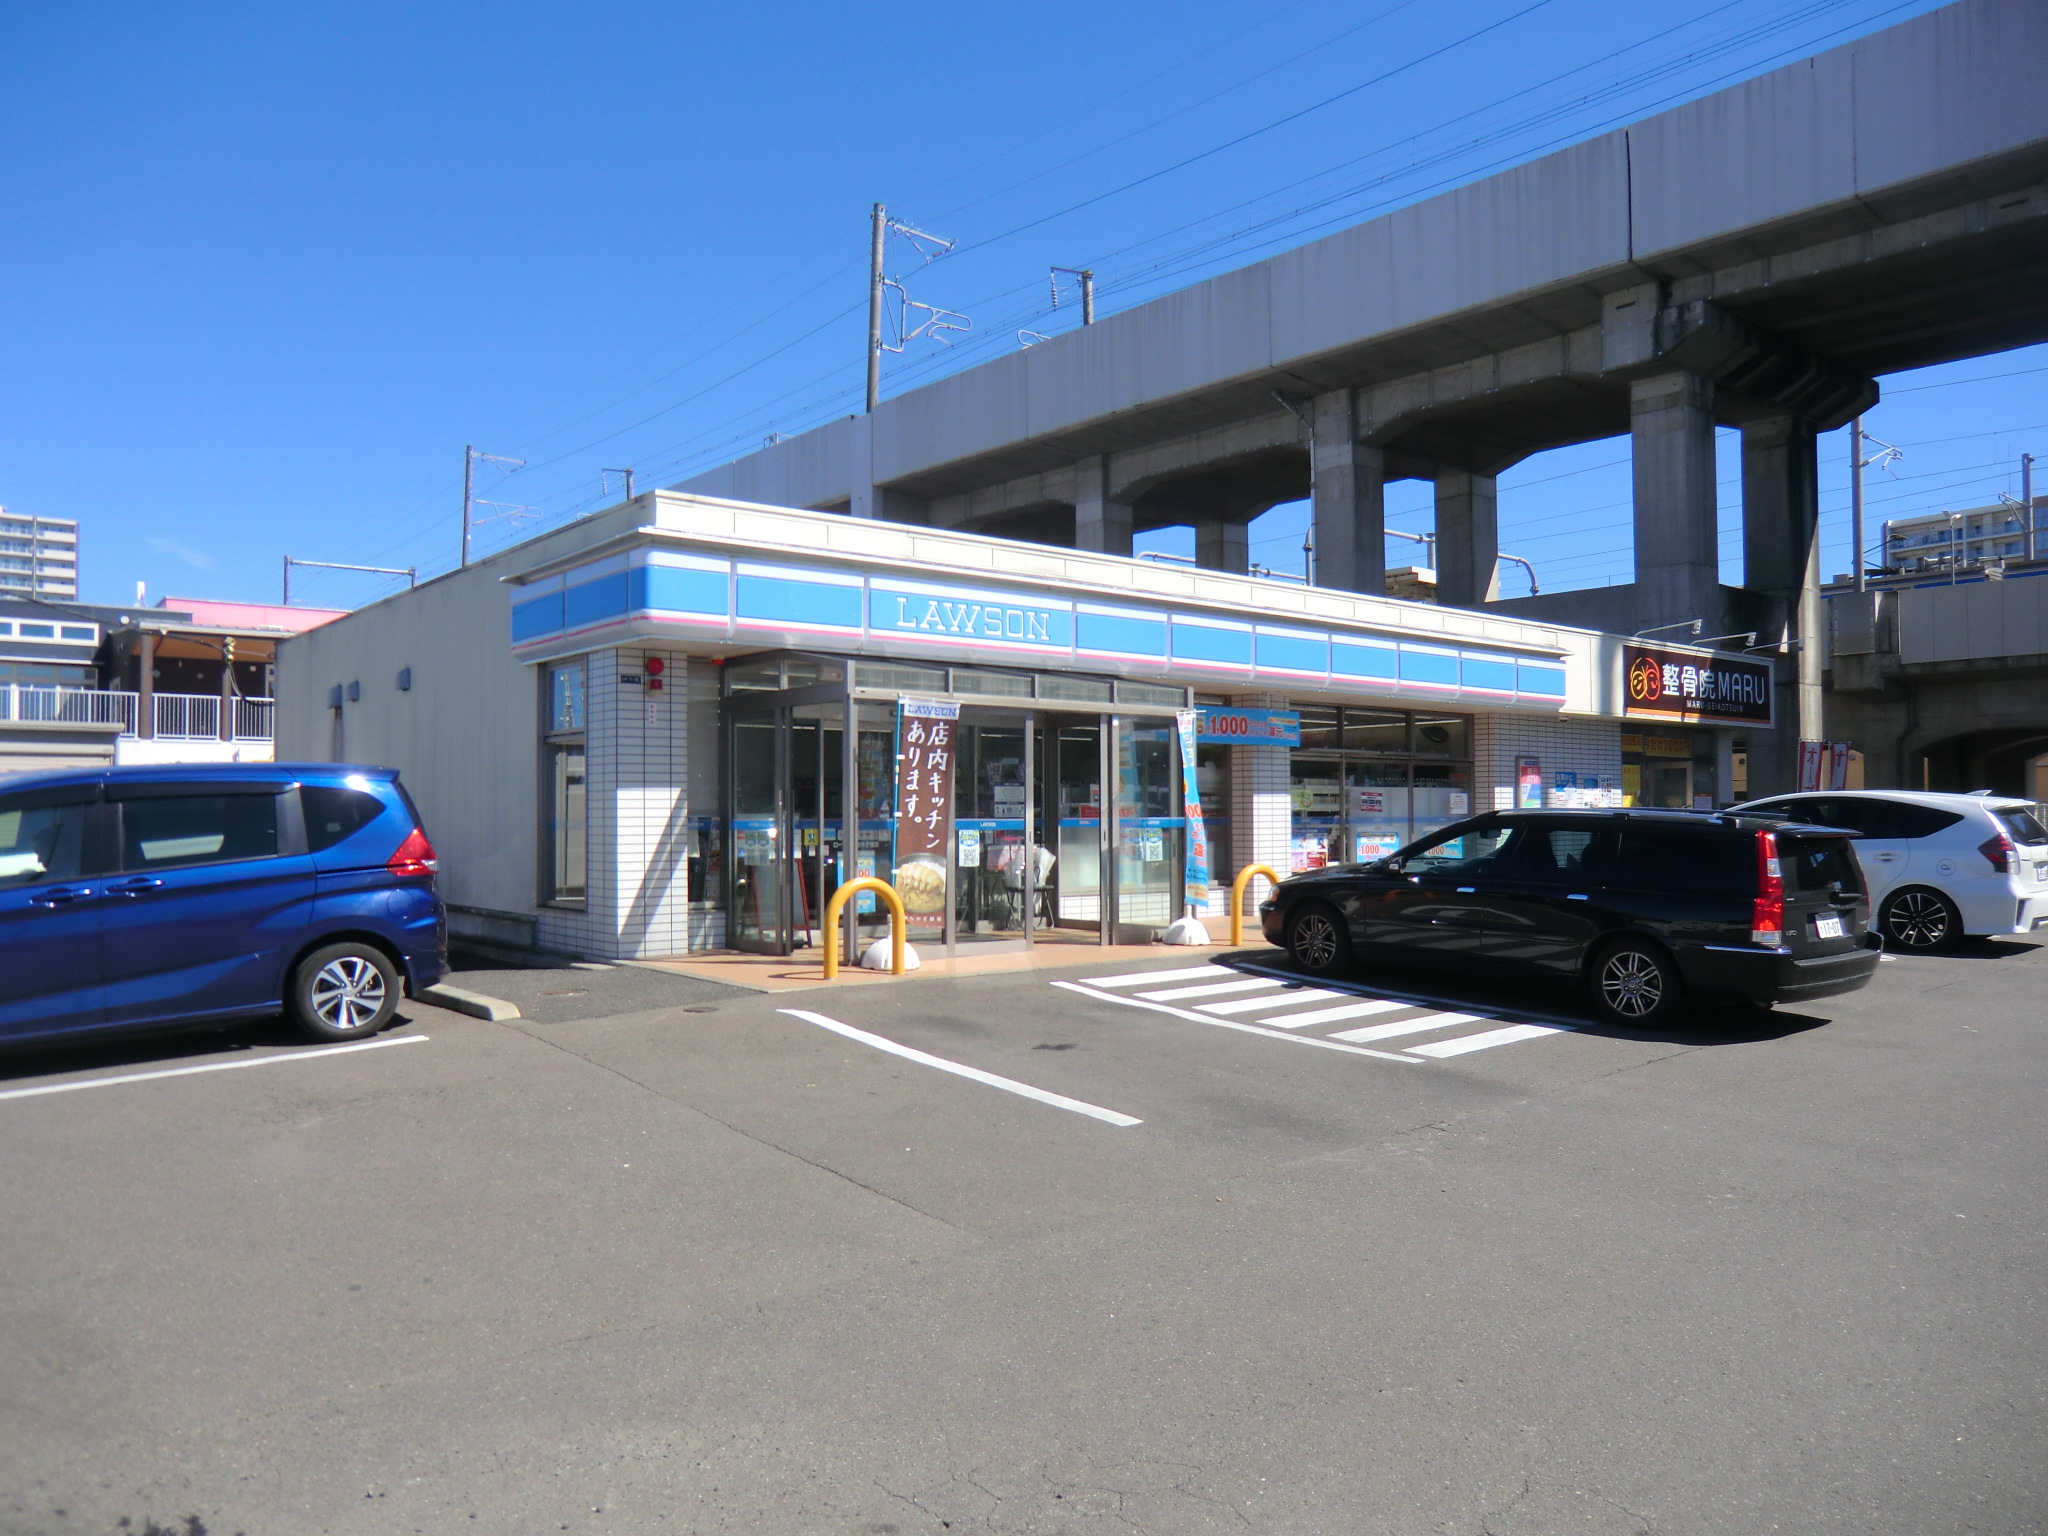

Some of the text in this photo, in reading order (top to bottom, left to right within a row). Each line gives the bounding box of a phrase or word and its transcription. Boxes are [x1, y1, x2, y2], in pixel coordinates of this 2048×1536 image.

[896, 596, 1050, 641] LAWSON
[1661, 664, 1765, 705] 整骨院 MARU
[907, 704, 957, 717] LAWSON
[904, 720, 926, 824] あります。
[925, 721, 950, 849] 店内キッチン
